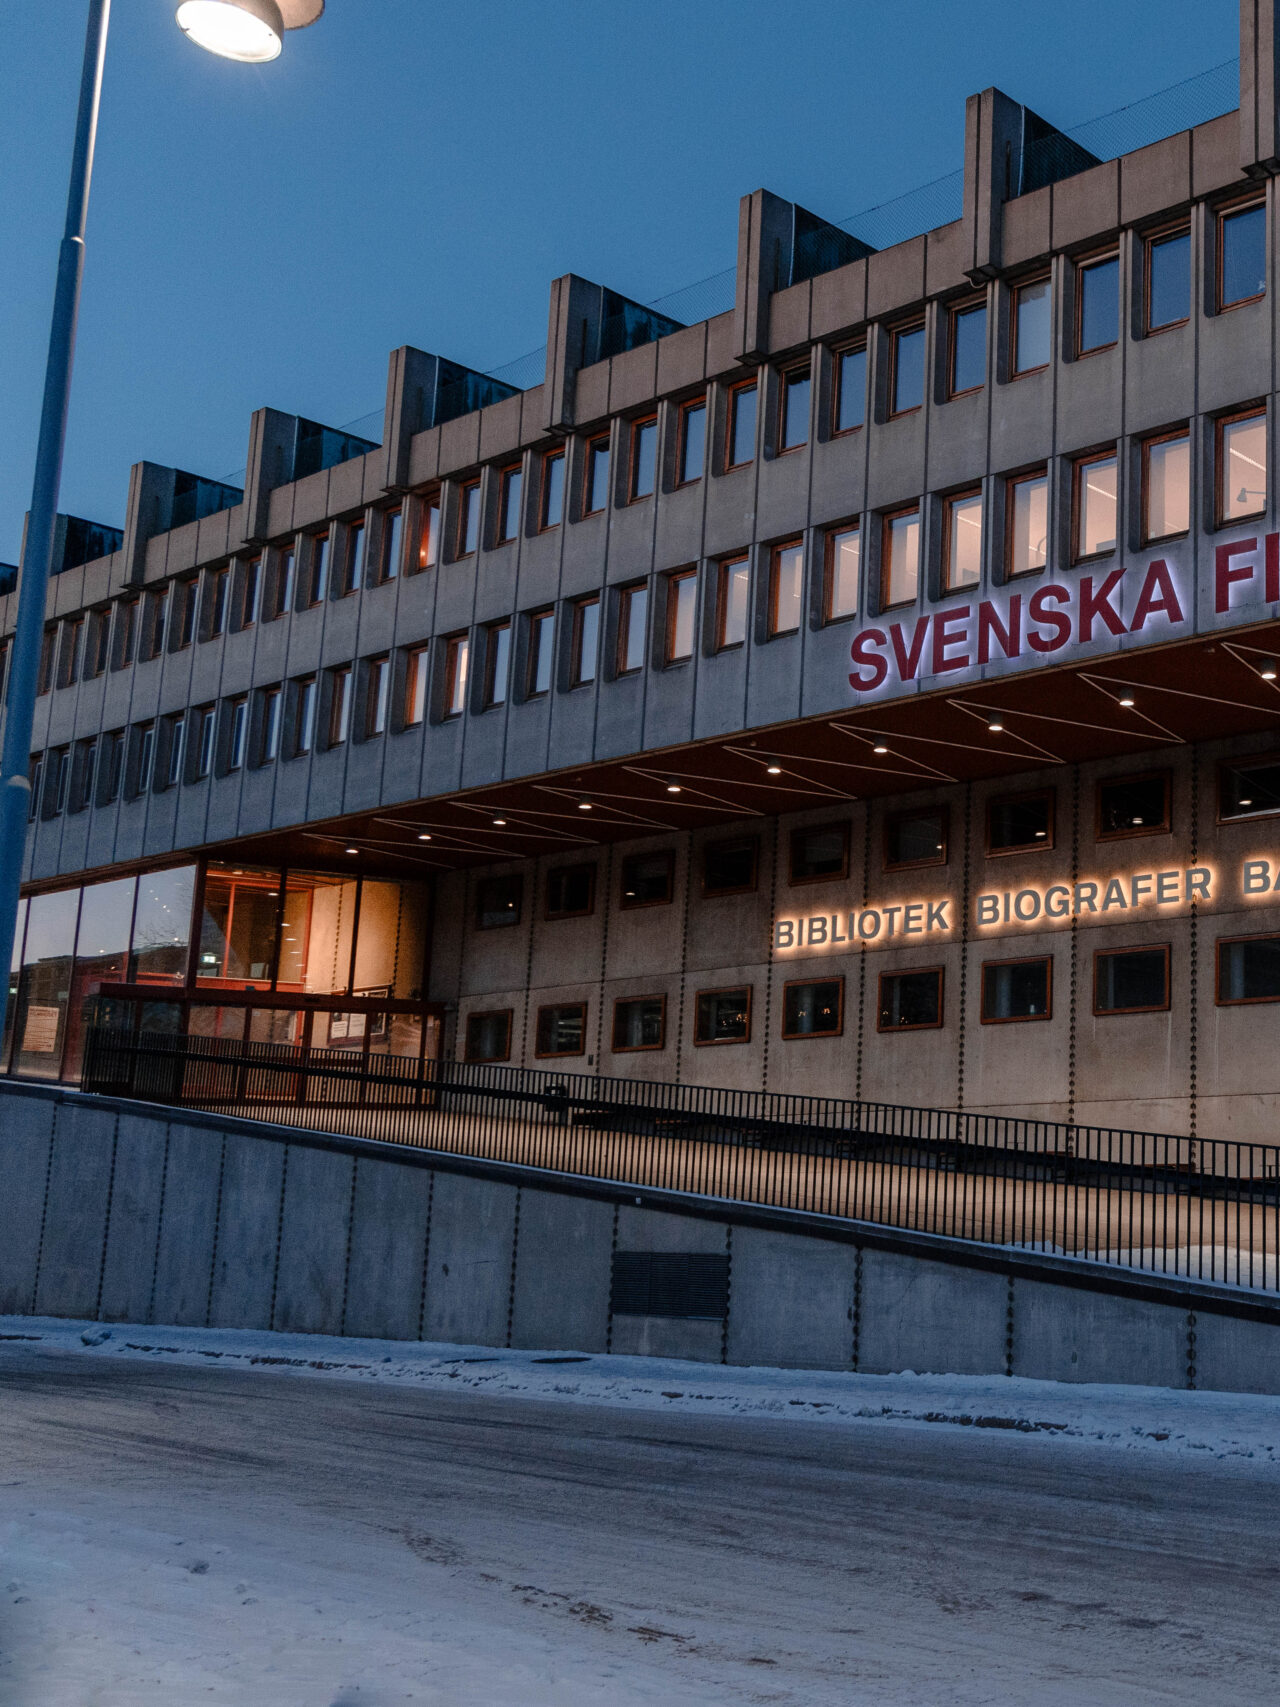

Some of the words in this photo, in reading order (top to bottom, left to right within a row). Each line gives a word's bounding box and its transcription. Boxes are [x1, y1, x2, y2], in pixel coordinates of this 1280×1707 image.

[848, 558, 1184, 692] SVENSKA
[773, 900, 950, 949] BIBLIOTEK
[976, 867, 1212, 925] BIOGRAFER
